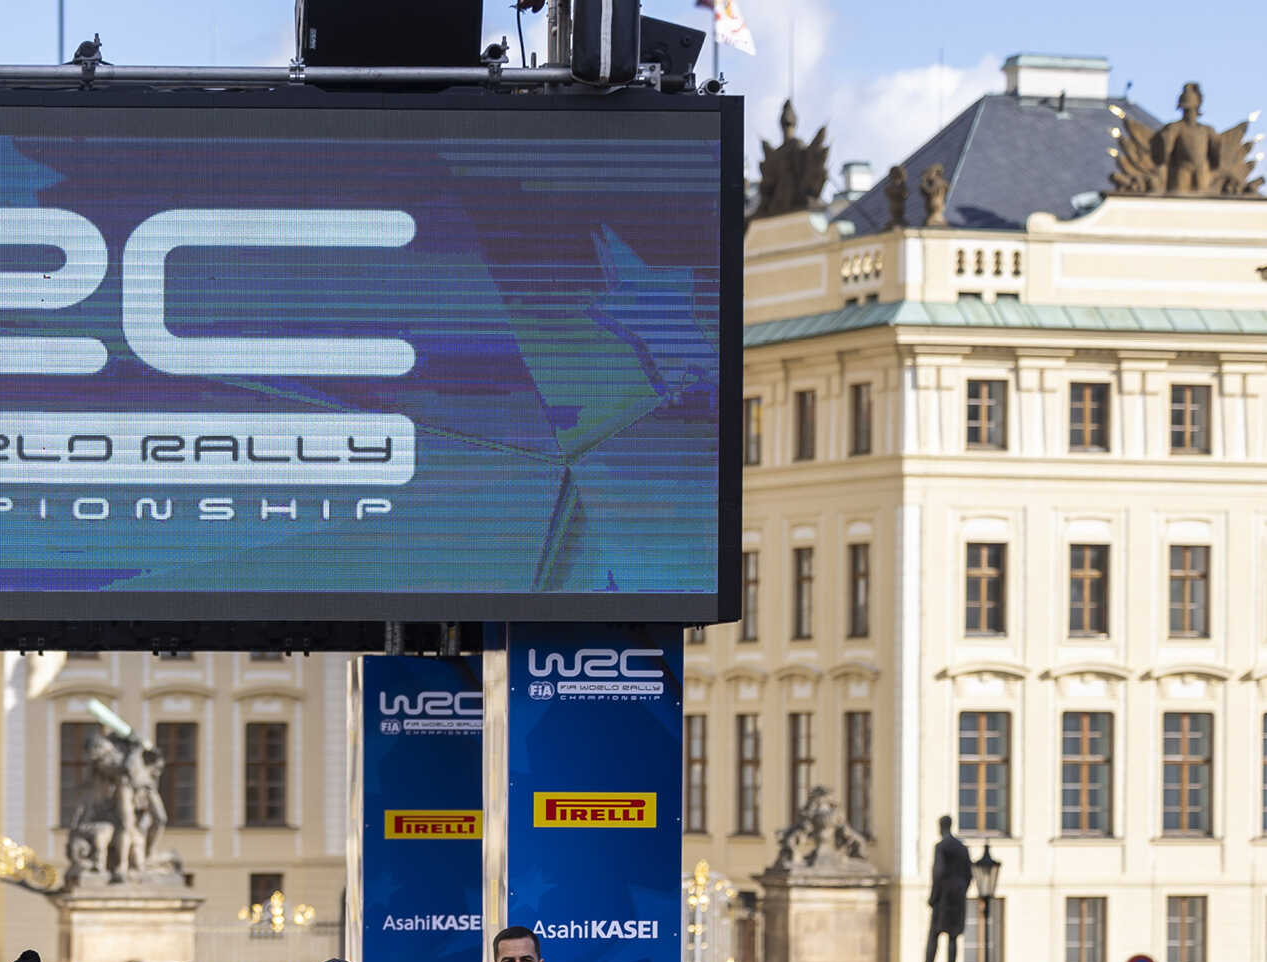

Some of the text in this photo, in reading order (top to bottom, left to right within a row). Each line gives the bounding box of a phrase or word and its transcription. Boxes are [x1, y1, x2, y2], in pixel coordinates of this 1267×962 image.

[140, 434, 393, 463] RALLY
[528, 648, 664, 678] WRC
[545, 798, 646, 821] PIRELLI
[394, 815, 476, 834] PIRELLI
[532, 919, 659, 939] AsahiKASEI
